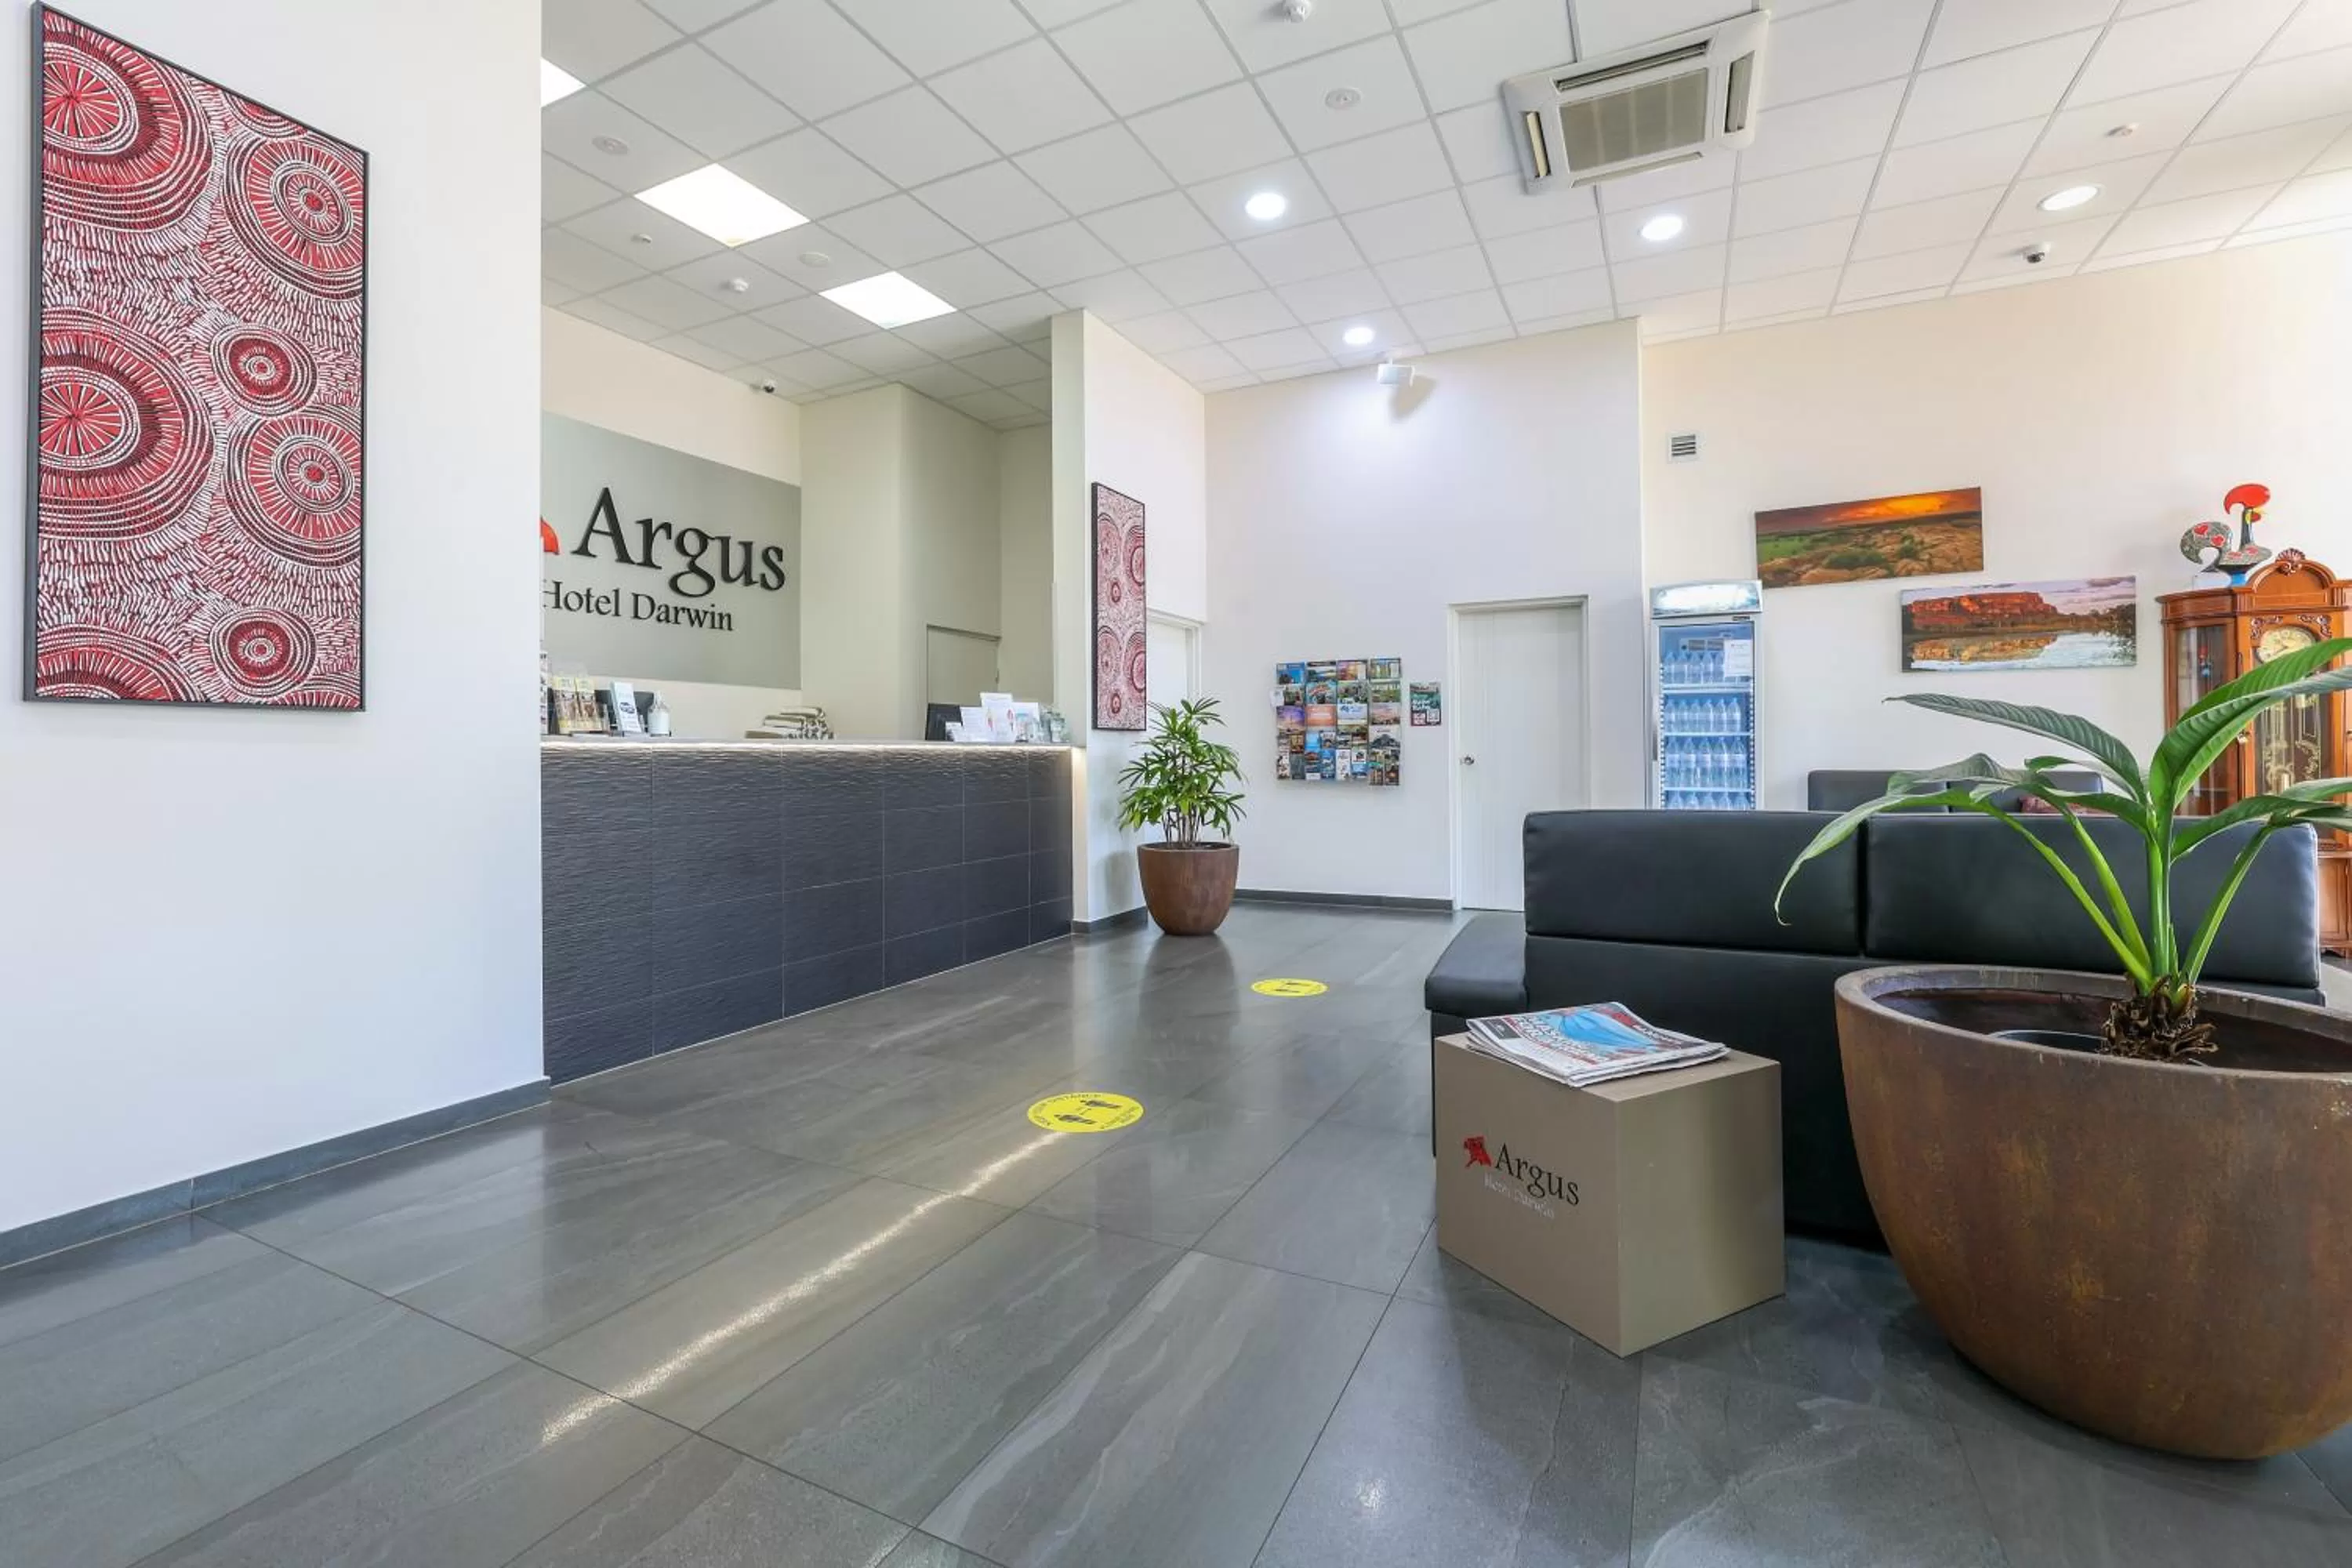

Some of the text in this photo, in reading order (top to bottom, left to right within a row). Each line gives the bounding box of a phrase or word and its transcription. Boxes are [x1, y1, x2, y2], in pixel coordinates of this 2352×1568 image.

[570, 487, 786, 597] Argus
[631, 592, 733, 631] Darwin
[1495, 1143, 1580, 1207] Argus
